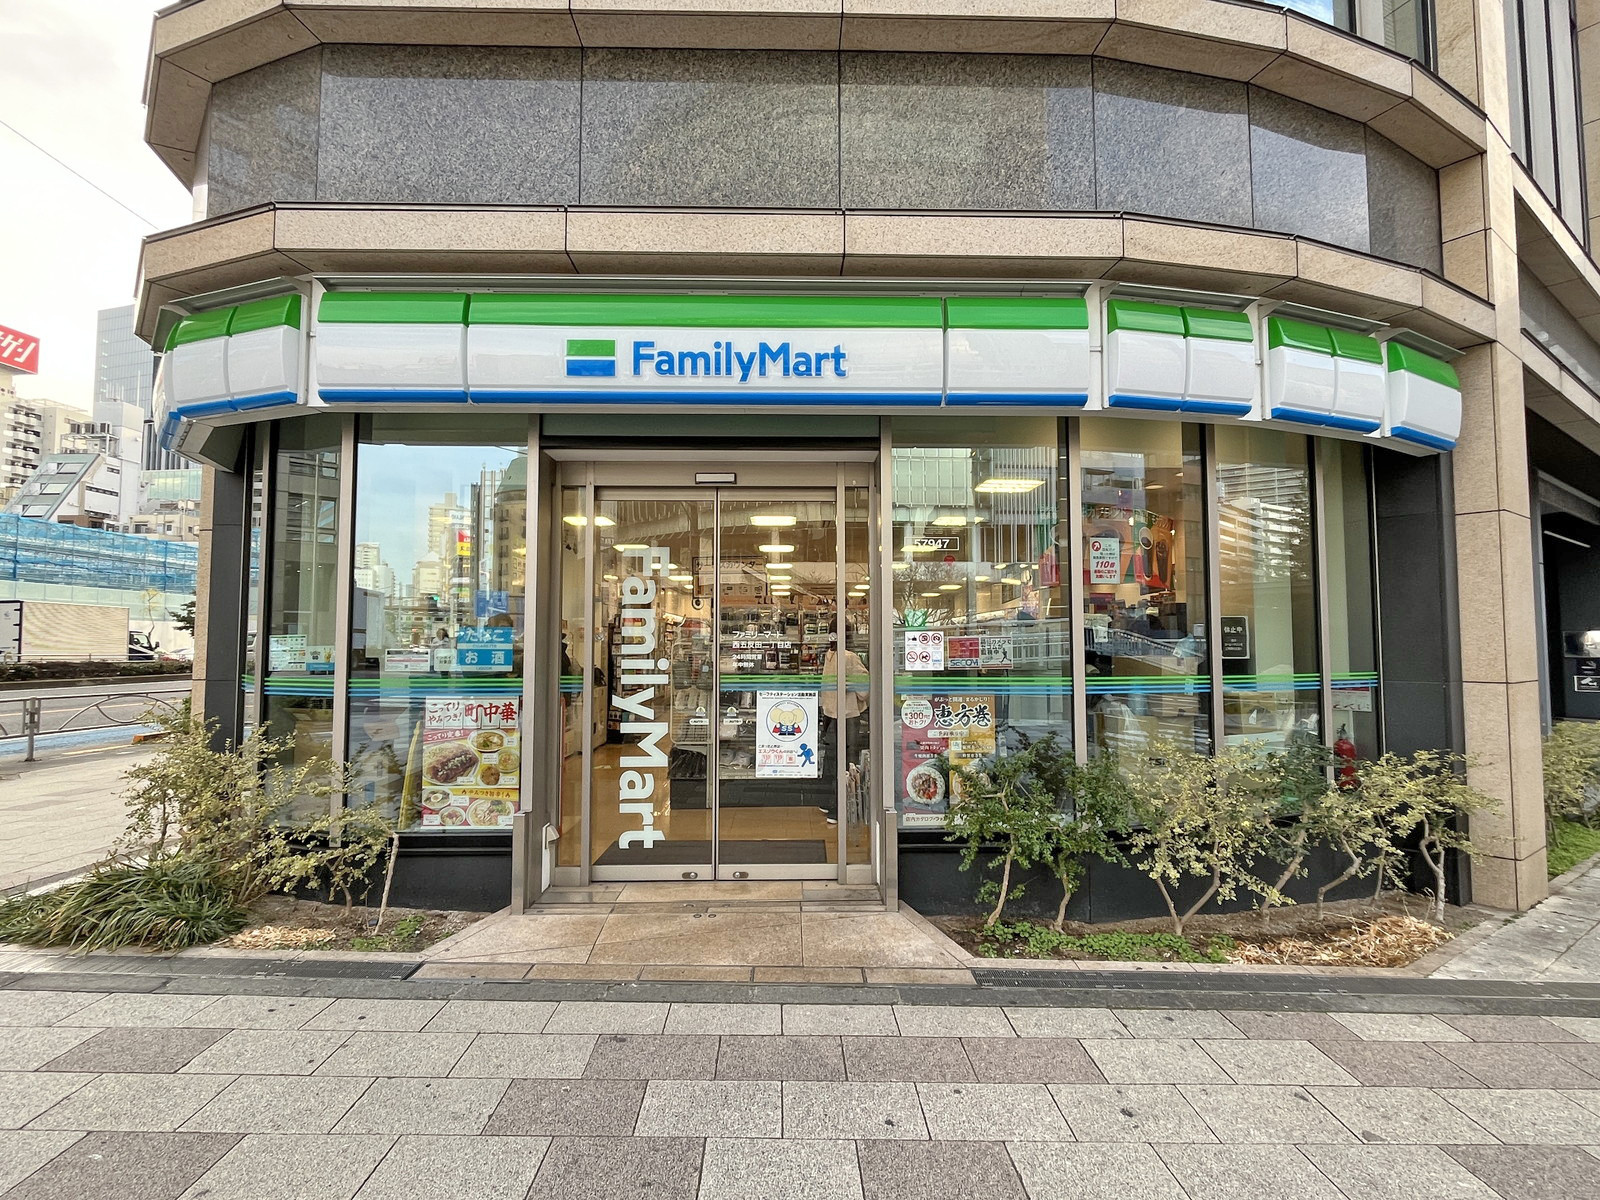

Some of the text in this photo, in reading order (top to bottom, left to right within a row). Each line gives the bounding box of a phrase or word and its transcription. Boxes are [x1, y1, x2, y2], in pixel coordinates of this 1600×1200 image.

[632, 341, 848, 383] FamilyMart
[465, 627, 505, 643] たばこ
[732, 631, 783, 639] ファミリーマート
[732, 641, 792, 649] 西五反田二丁目店
[950, 659, 979, 667] SECOM
[612, 546, 671, 849] FamilyMart
[428, 702, 460, 713] こってり
[464, 701, 518, 724] 町中華
[935, 703, 992, 728] 恵方巻
